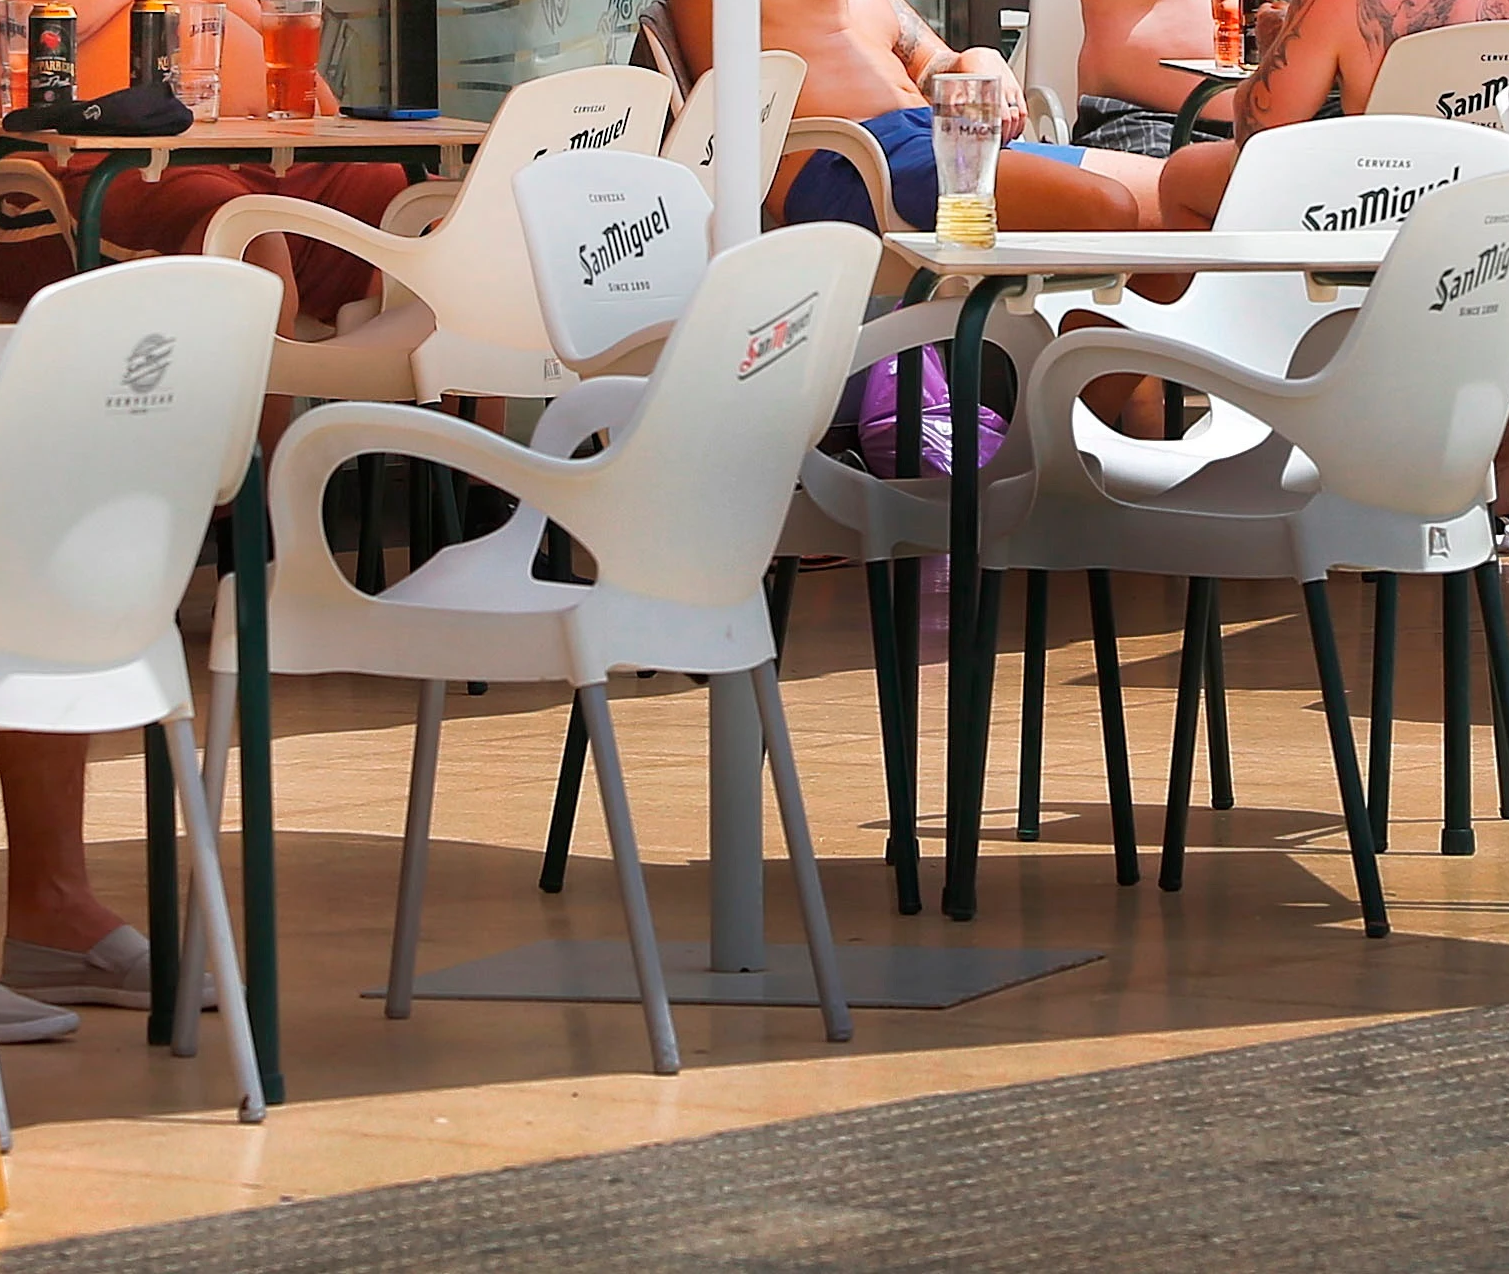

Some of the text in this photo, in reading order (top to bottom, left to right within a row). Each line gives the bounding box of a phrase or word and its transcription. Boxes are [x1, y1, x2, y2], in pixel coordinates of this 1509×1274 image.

[573, 104, 606, 114] CERVEZAS
[1356, 157, 1413, 170] CERVEZAS
[588, 193, 626, 204] CERVEZAS
[578, 195, 671, 286] SanMiguel
[608, 282, 630, 293] SINCE
